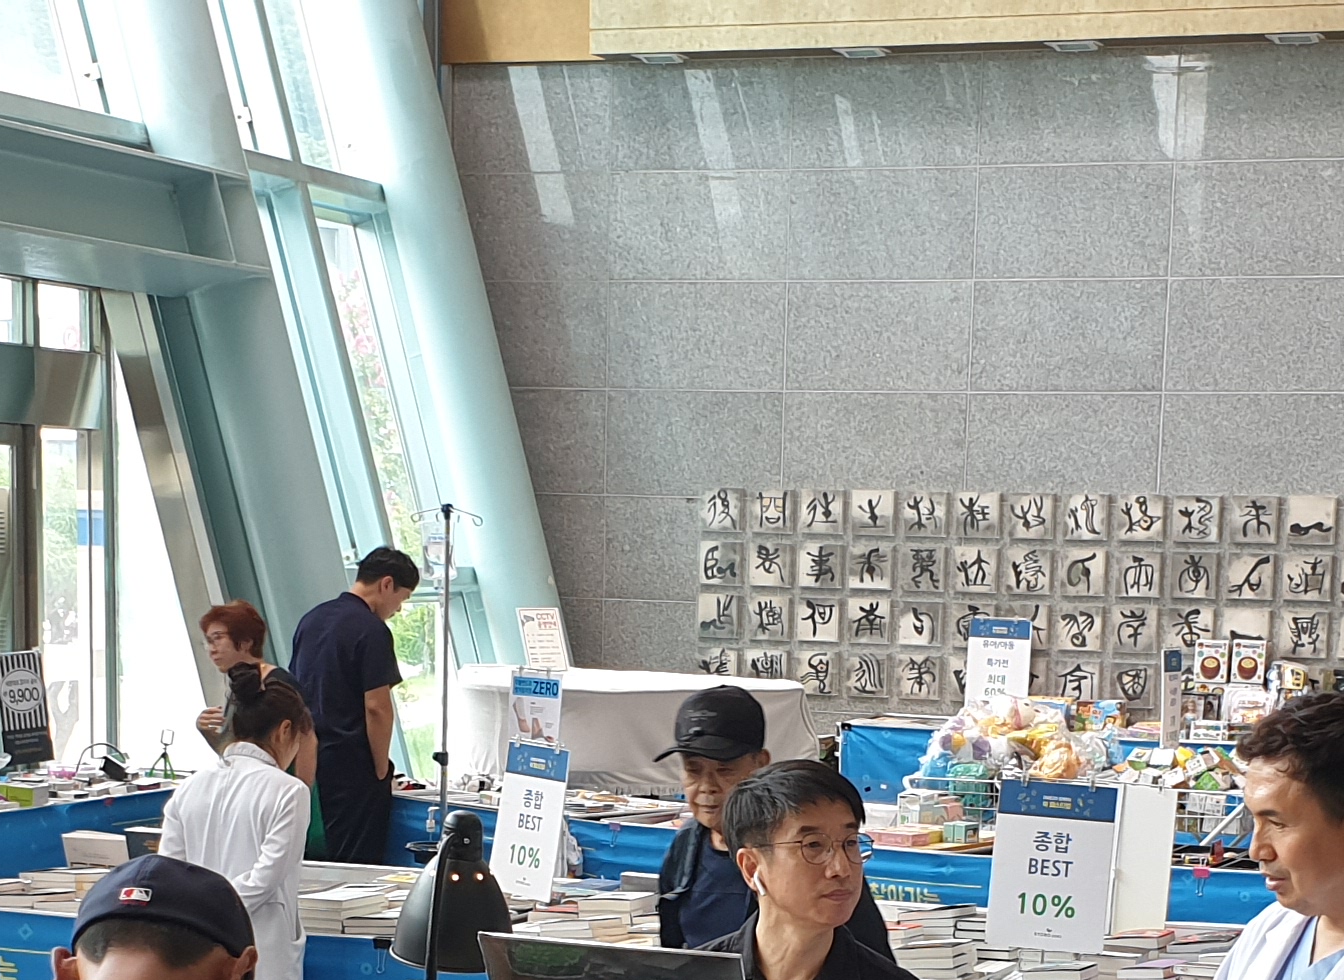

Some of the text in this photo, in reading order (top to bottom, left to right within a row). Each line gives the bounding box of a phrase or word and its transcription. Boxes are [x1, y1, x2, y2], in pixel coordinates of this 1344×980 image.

[535, 612, 555, 622] CCTV
[8, 686, 40, 705] 9,900
[532, 680, 559, 697] ZERO
[522, 789, 545, 810] 종합
[517, 813, 544, 833] BEST
[1032, 830, 1073, 855] 종합
[508, 843, 541, 870] 10%
[1027, 857, 1074, 879] BEST
[1017, 891, 1077, 919] 10%
